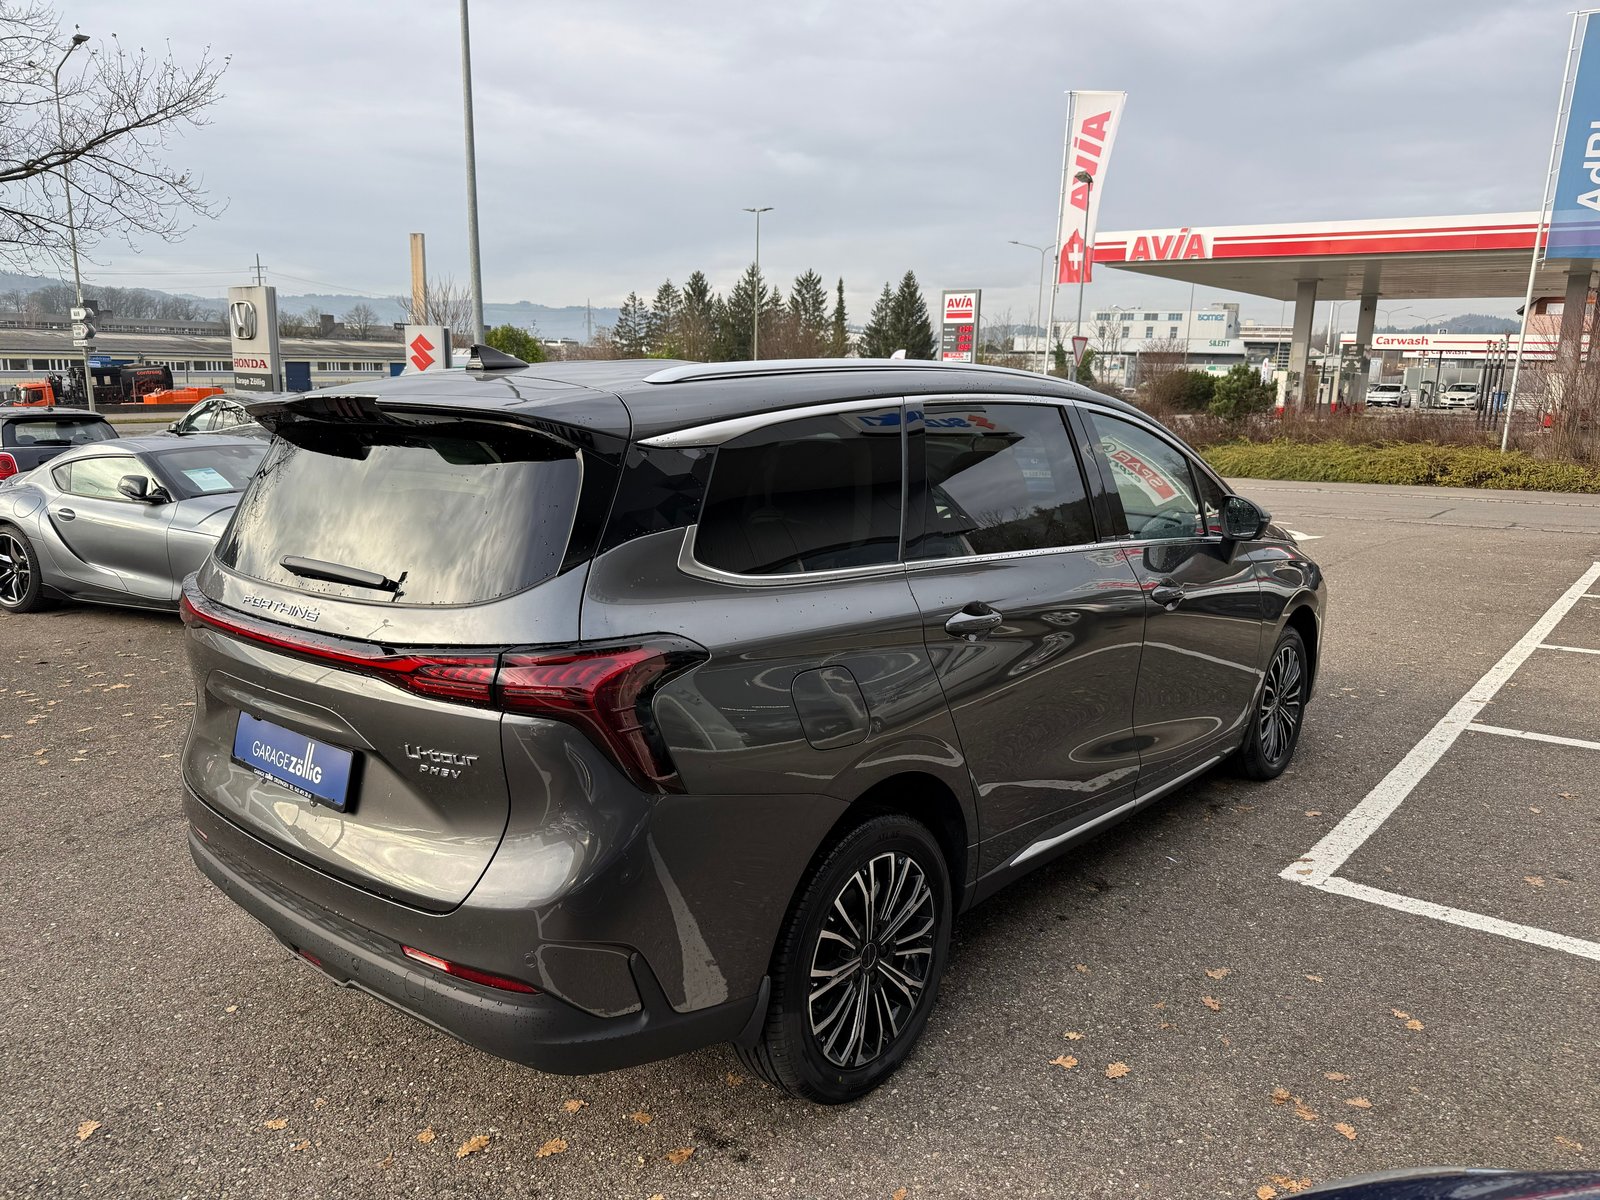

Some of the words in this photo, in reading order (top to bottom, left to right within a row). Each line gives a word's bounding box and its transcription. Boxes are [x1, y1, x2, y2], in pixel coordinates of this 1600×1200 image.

[1375, 336, 1430, 346] Carwash
[233, 358, 269, 369] HONDA
[419, 763, 462, 779] PHEV
